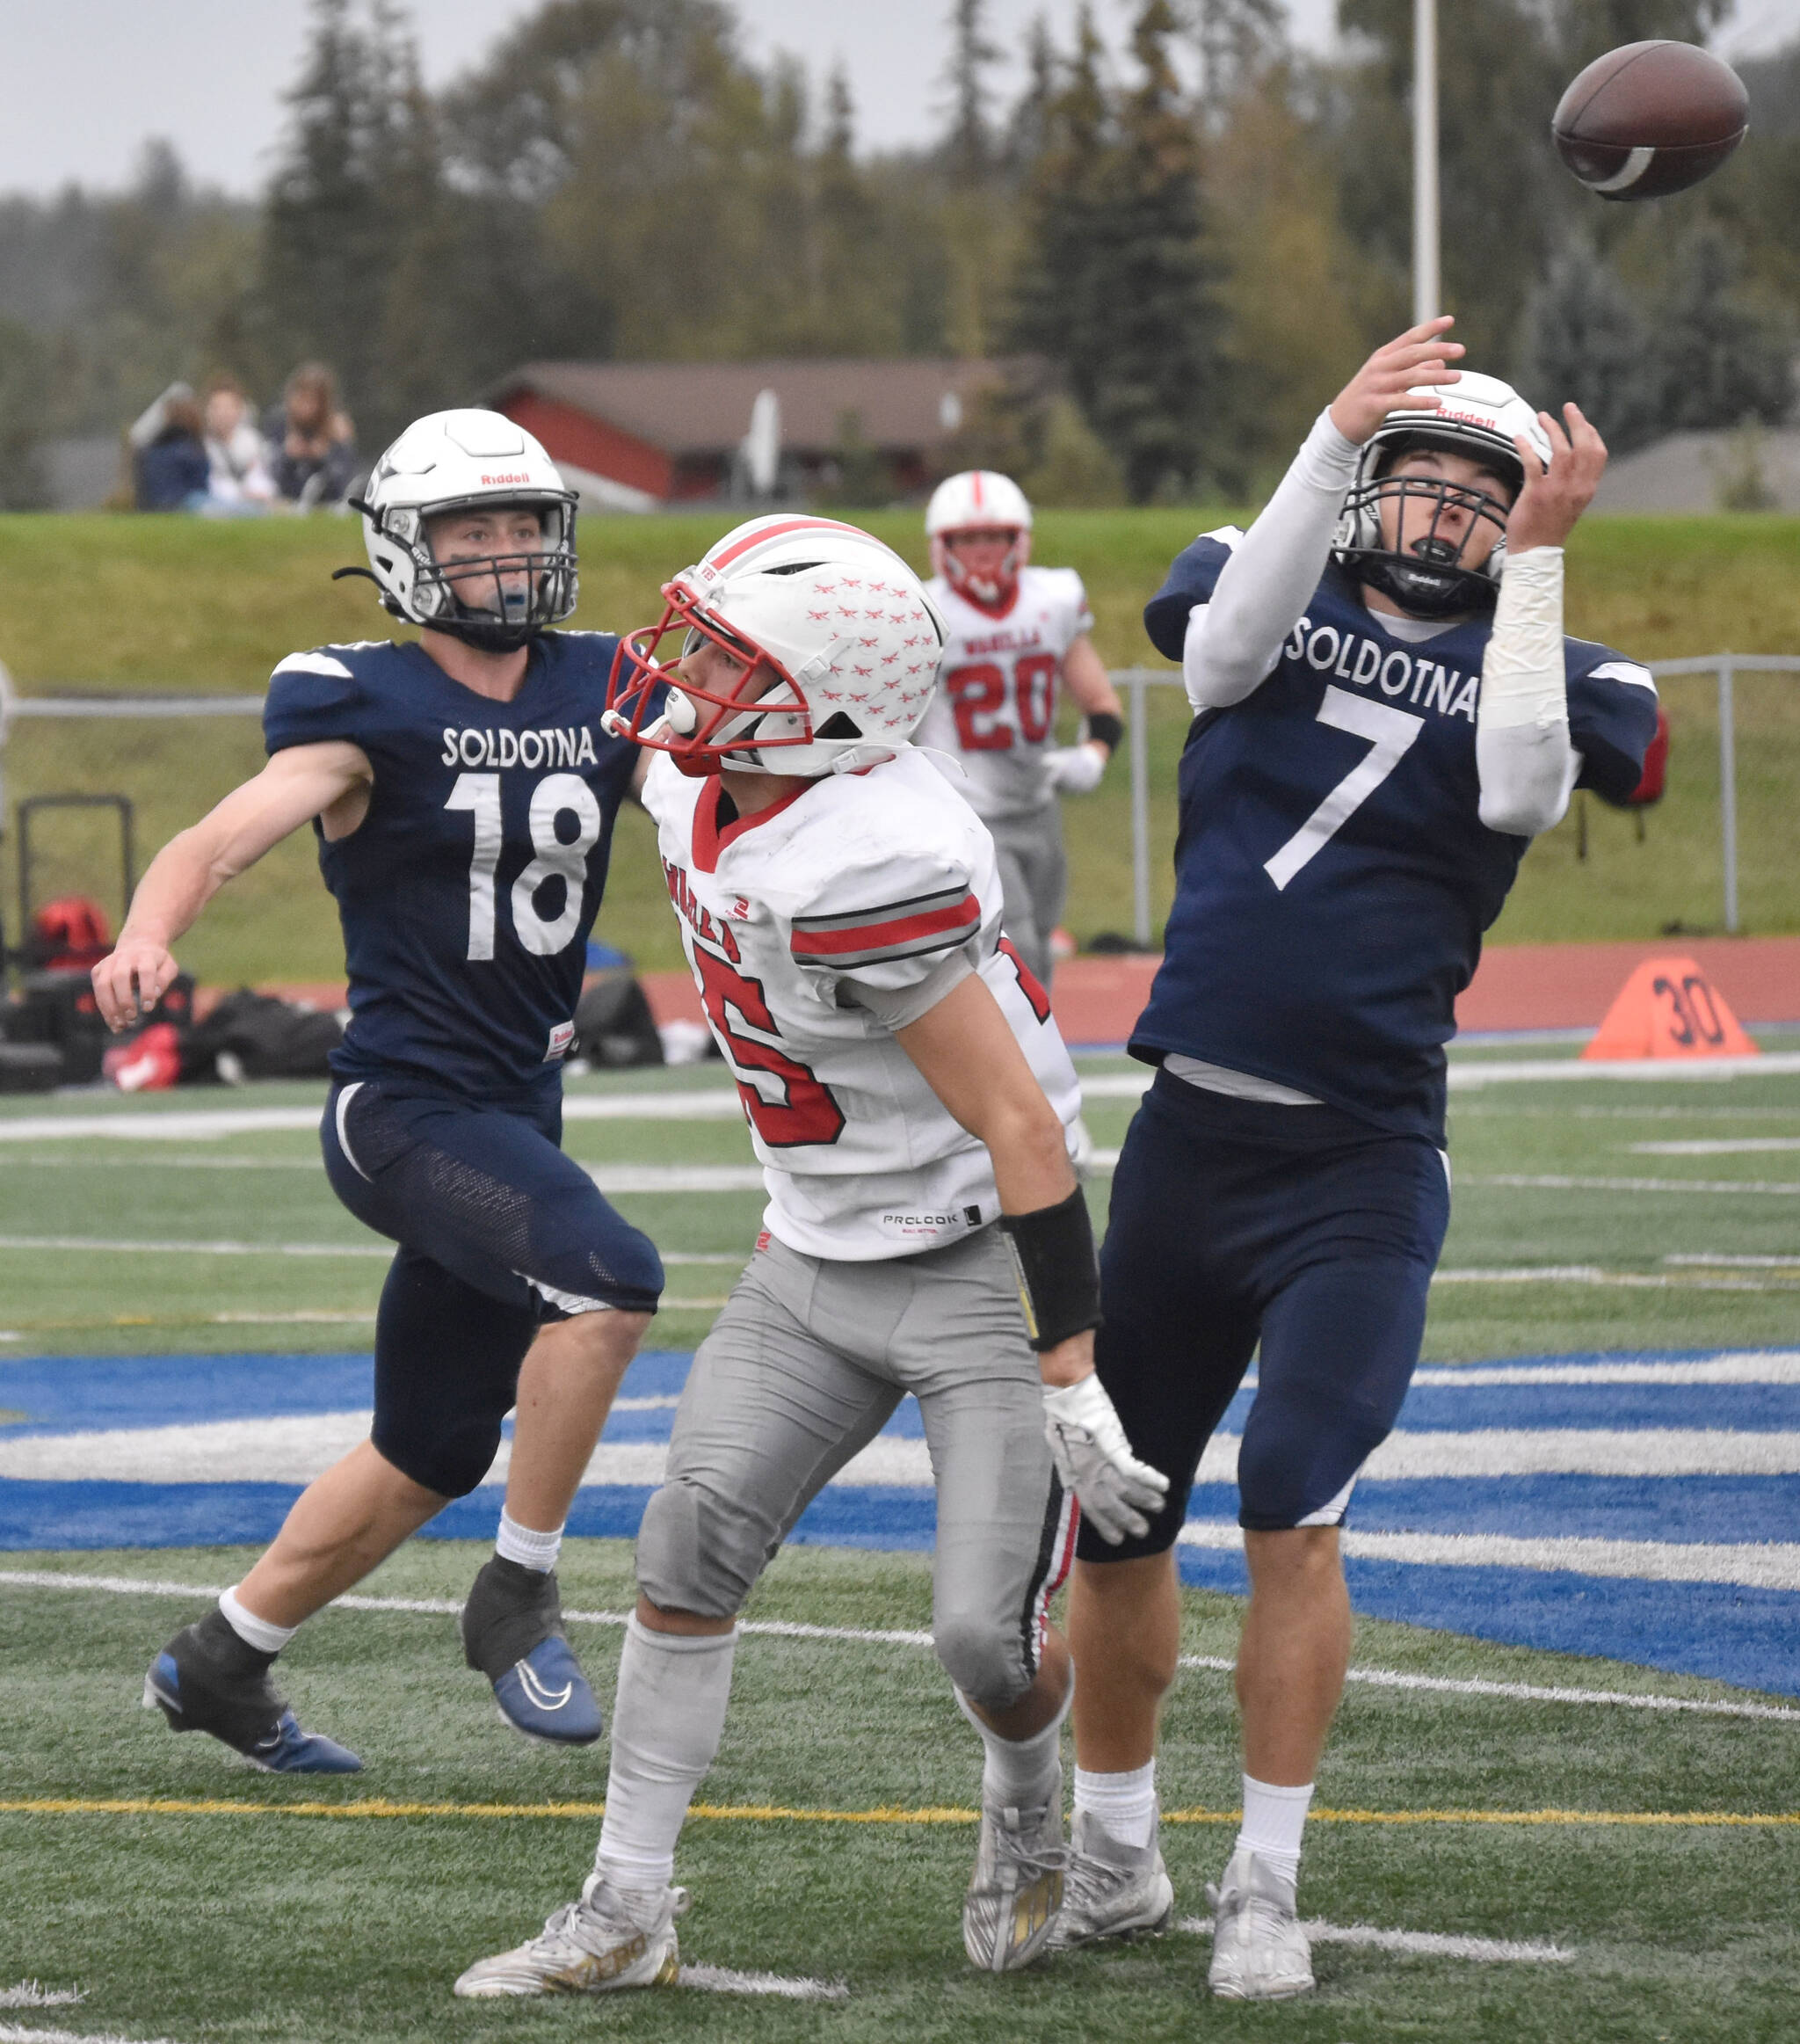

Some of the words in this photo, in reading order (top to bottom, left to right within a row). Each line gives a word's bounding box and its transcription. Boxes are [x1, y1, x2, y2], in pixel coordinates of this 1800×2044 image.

[1436, 407, 1496, 430] Riddell
[480, 472, 530, 485] Riddell
[947, 651, 1057, 753] 20
[1285, 616, 1479, 724] SOLDOTNA
[441, 726, 599, 768] SOLDOTNA
[1264, 683, 1426, 891] 7
[444, 773, 601, 961] 18
[1652, 976, 1725, 1045] 30
